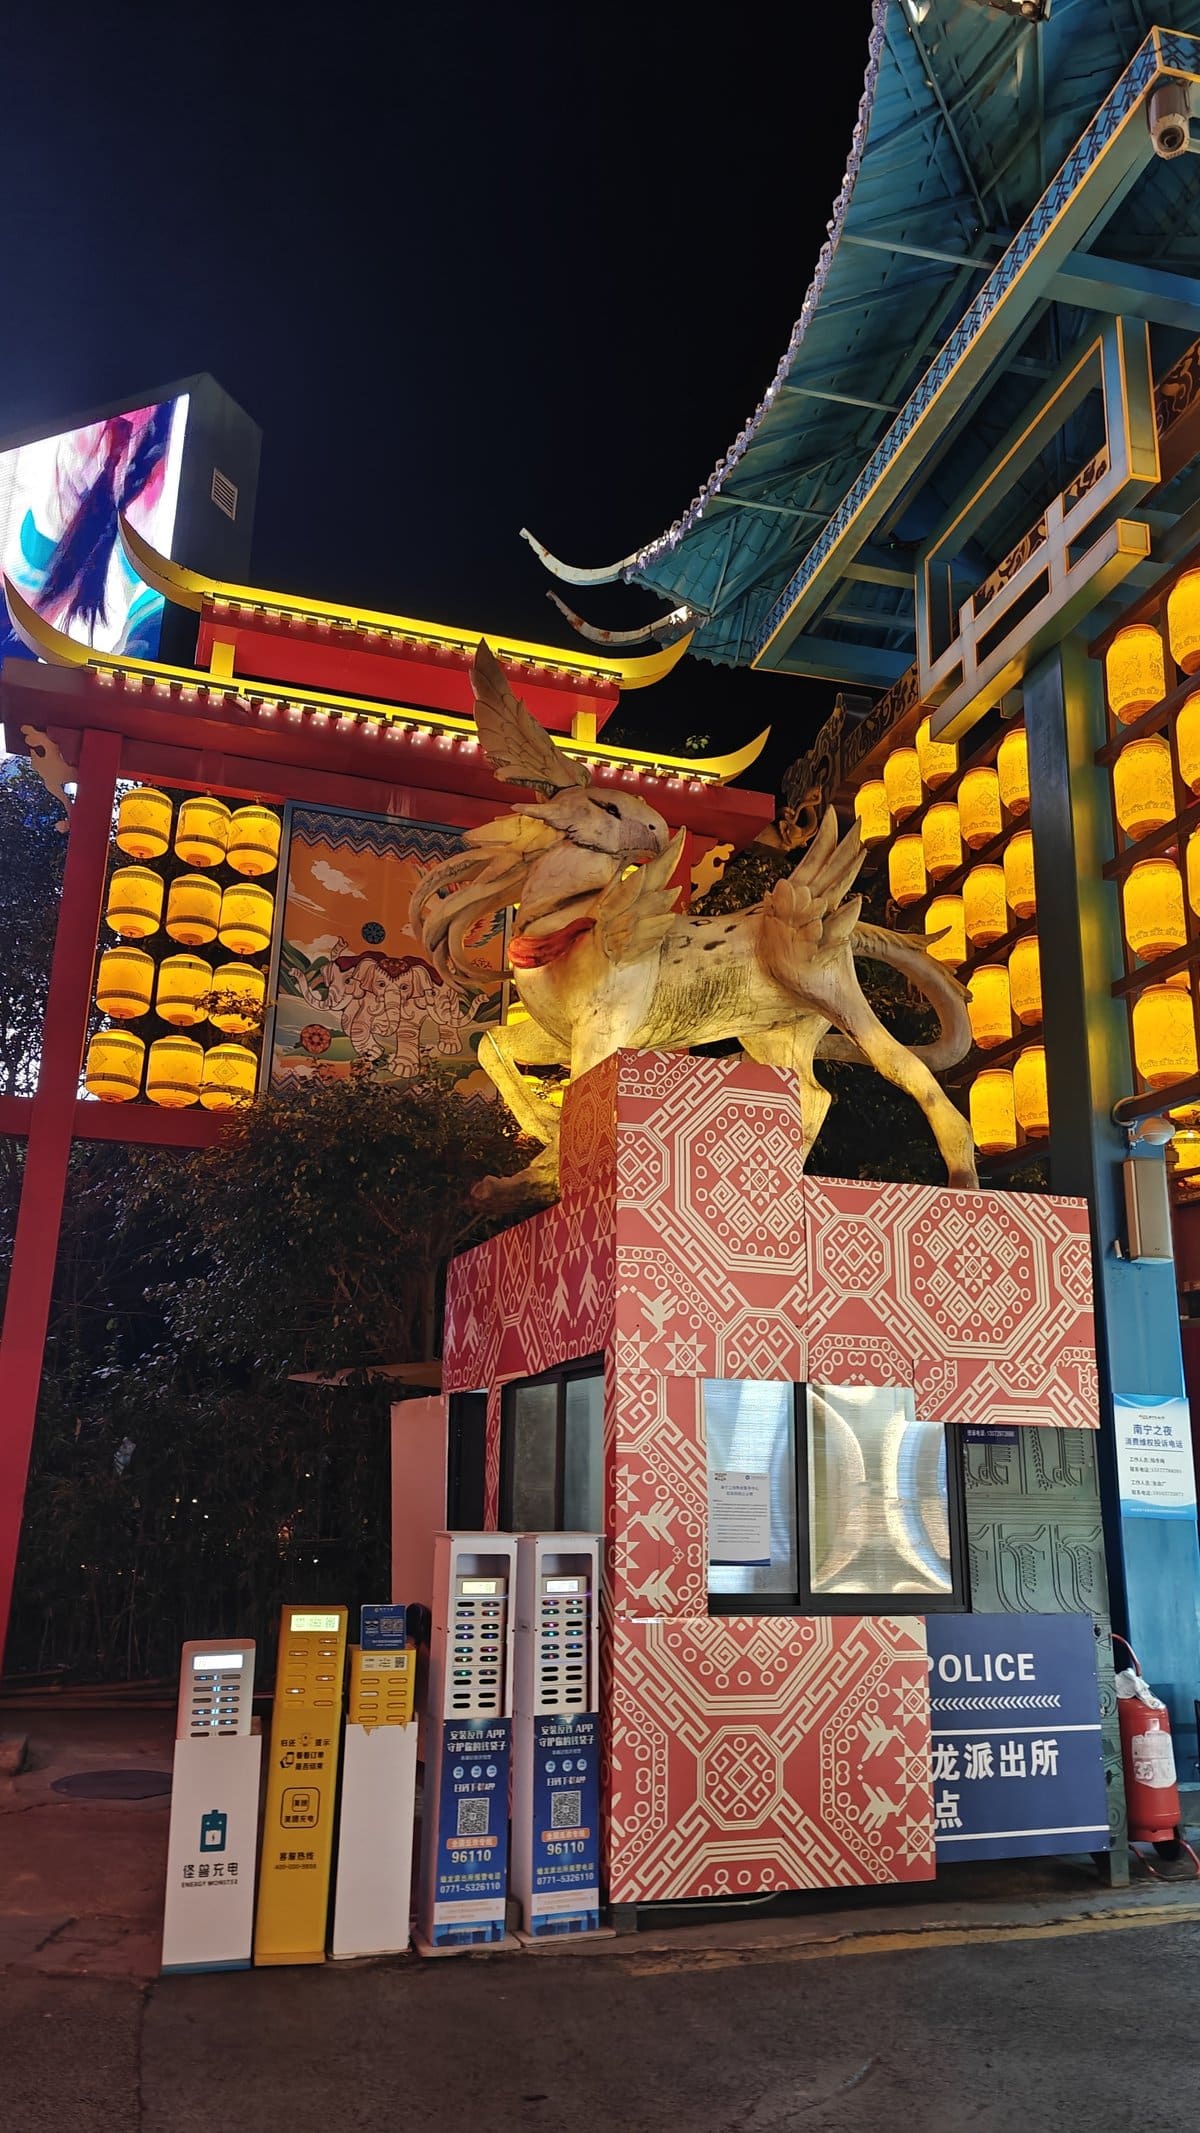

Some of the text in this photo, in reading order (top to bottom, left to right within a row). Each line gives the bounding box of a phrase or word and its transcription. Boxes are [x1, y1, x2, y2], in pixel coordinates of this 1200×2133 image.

[1133, 1424, 1173, 1437] 南宁之夜
[1125, 1437, 1184, 1449] 消费维权投诉电话
[486, 1729, 506, 1739] APP
[575, 1723, 594, 1733] APP
[932, 1739, 1059, 1781] 龙派出所
[934, 1790, 963, 1829] 点
[547, 1841, 585, 1855] 96110
[451, 1849, 491, 1863] 96110
[183, 1862, 239, 1879] 怪兽充电
[536, 1873, 594, 1885] 0771-5326110
[440, 1882, 501, 1893] 0771-5326110
